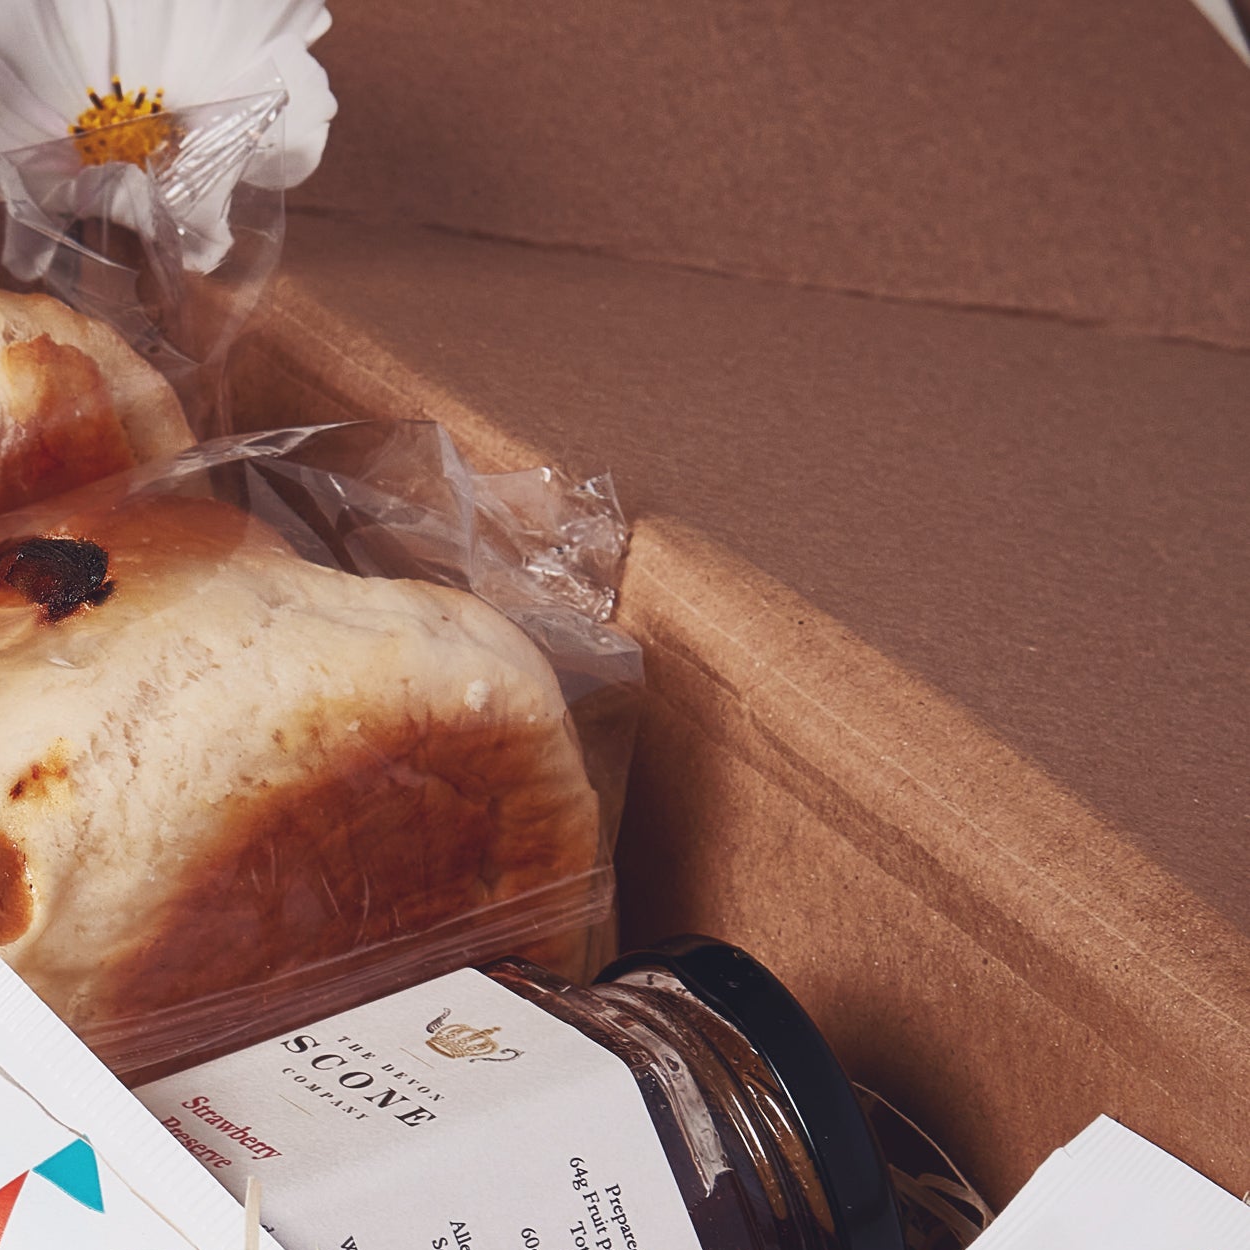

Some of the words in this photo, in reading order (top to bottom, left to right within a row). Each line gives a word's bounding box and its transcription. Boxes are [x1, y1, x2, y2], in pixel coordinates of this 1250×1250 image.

[280, 1035, 437, 1127] SCONE
[282, 1067, 369, 1121] COMPANY
[337, 1035, 376, 1060] THE
[380, 1063, 445, 1102] DEVON
[162, 1116, 233, 1169] Preserve
[181, 1095, 282, 1161] Strawberry
[569, 1157, 589, 1190] 64g
[582, 1190, 609, 1234] Fruit
